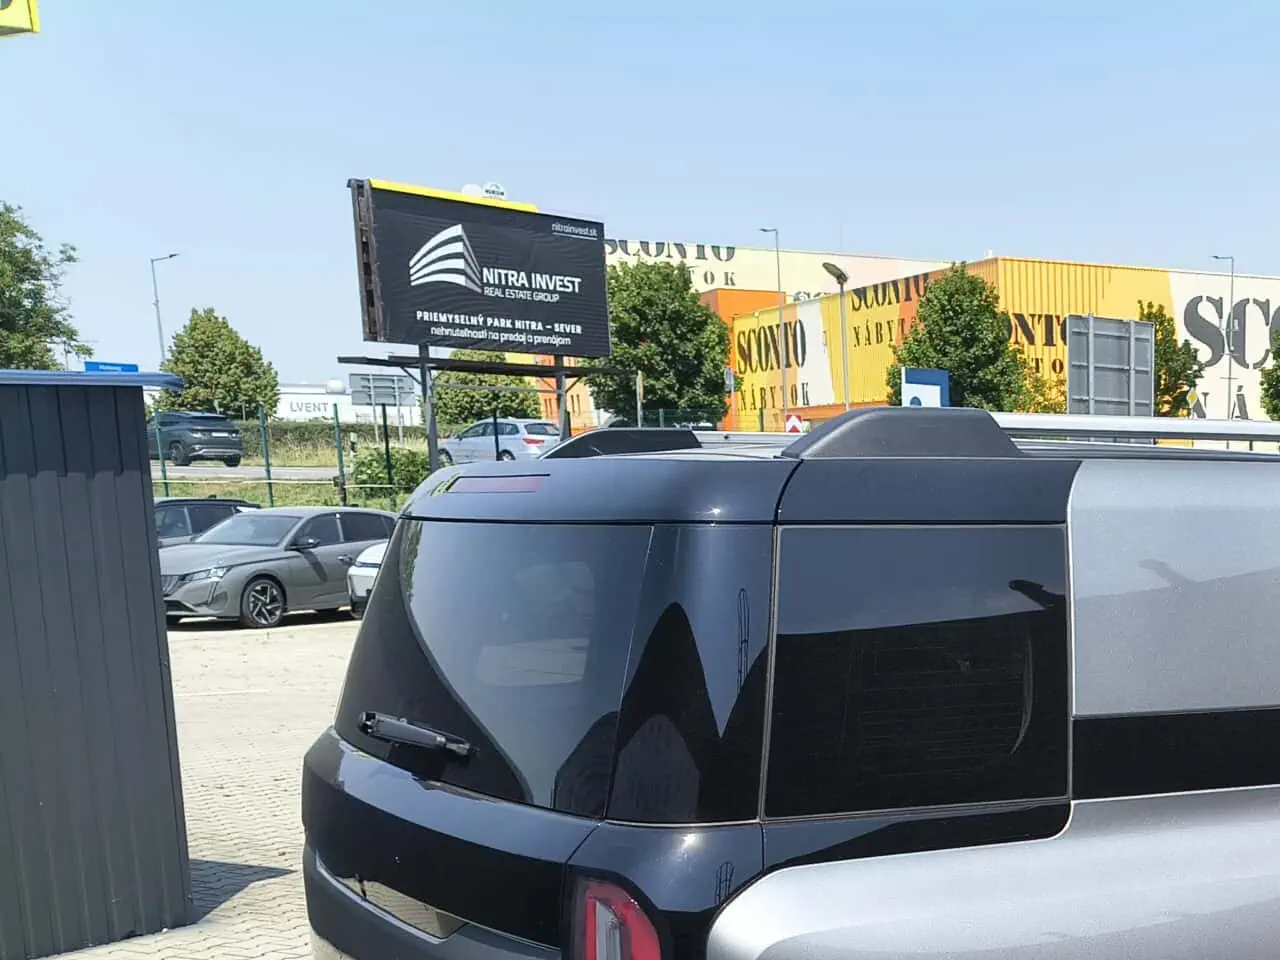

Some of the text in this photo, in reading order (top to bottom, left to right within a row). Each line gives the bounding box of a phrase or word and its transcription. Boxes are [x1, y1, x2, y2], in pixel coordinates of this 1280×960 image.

[482, 267, 581, 293] NITRA INVEST
[484, 287, 560, 302] REAL ESTATE GROUP
[486, 317, 512, 329] PARK
[514, 319, 544, 331] NITRA
[554, 323, 582, 335] SEVER
[737, 319, 807, 375] SCONTO
